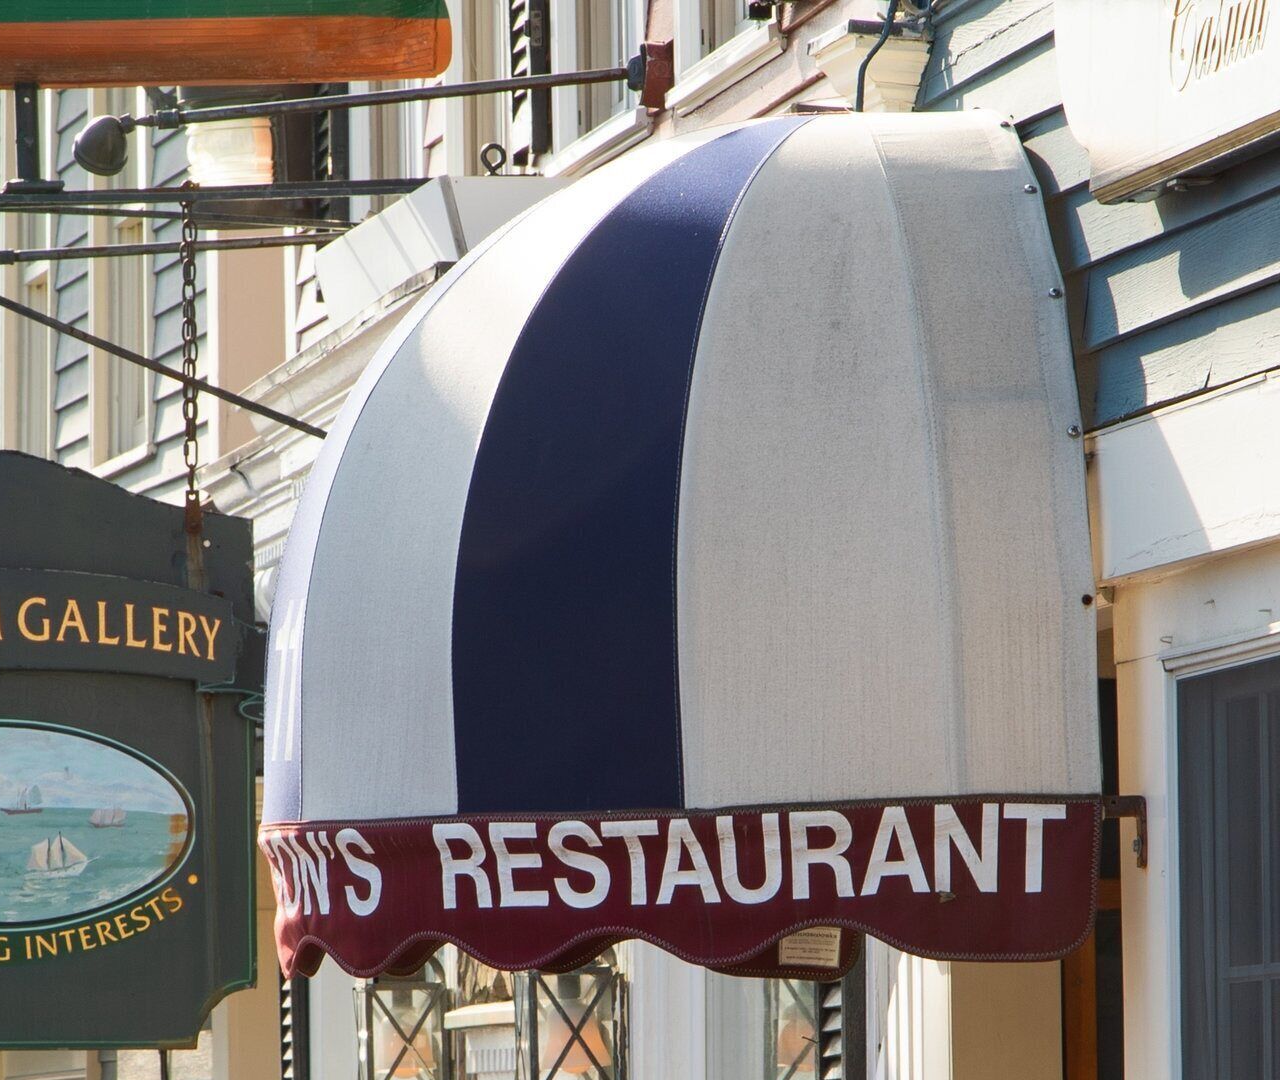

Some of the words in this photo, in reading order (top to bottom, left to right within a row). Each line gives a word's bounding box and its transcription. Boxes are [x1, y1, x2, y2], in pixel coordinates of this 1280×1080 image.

[18, 595, 222, 662] GALLERY
[431, 802, 1068, 912] RESTAURANT
[24, 886, 185, 961] INTERESTS
